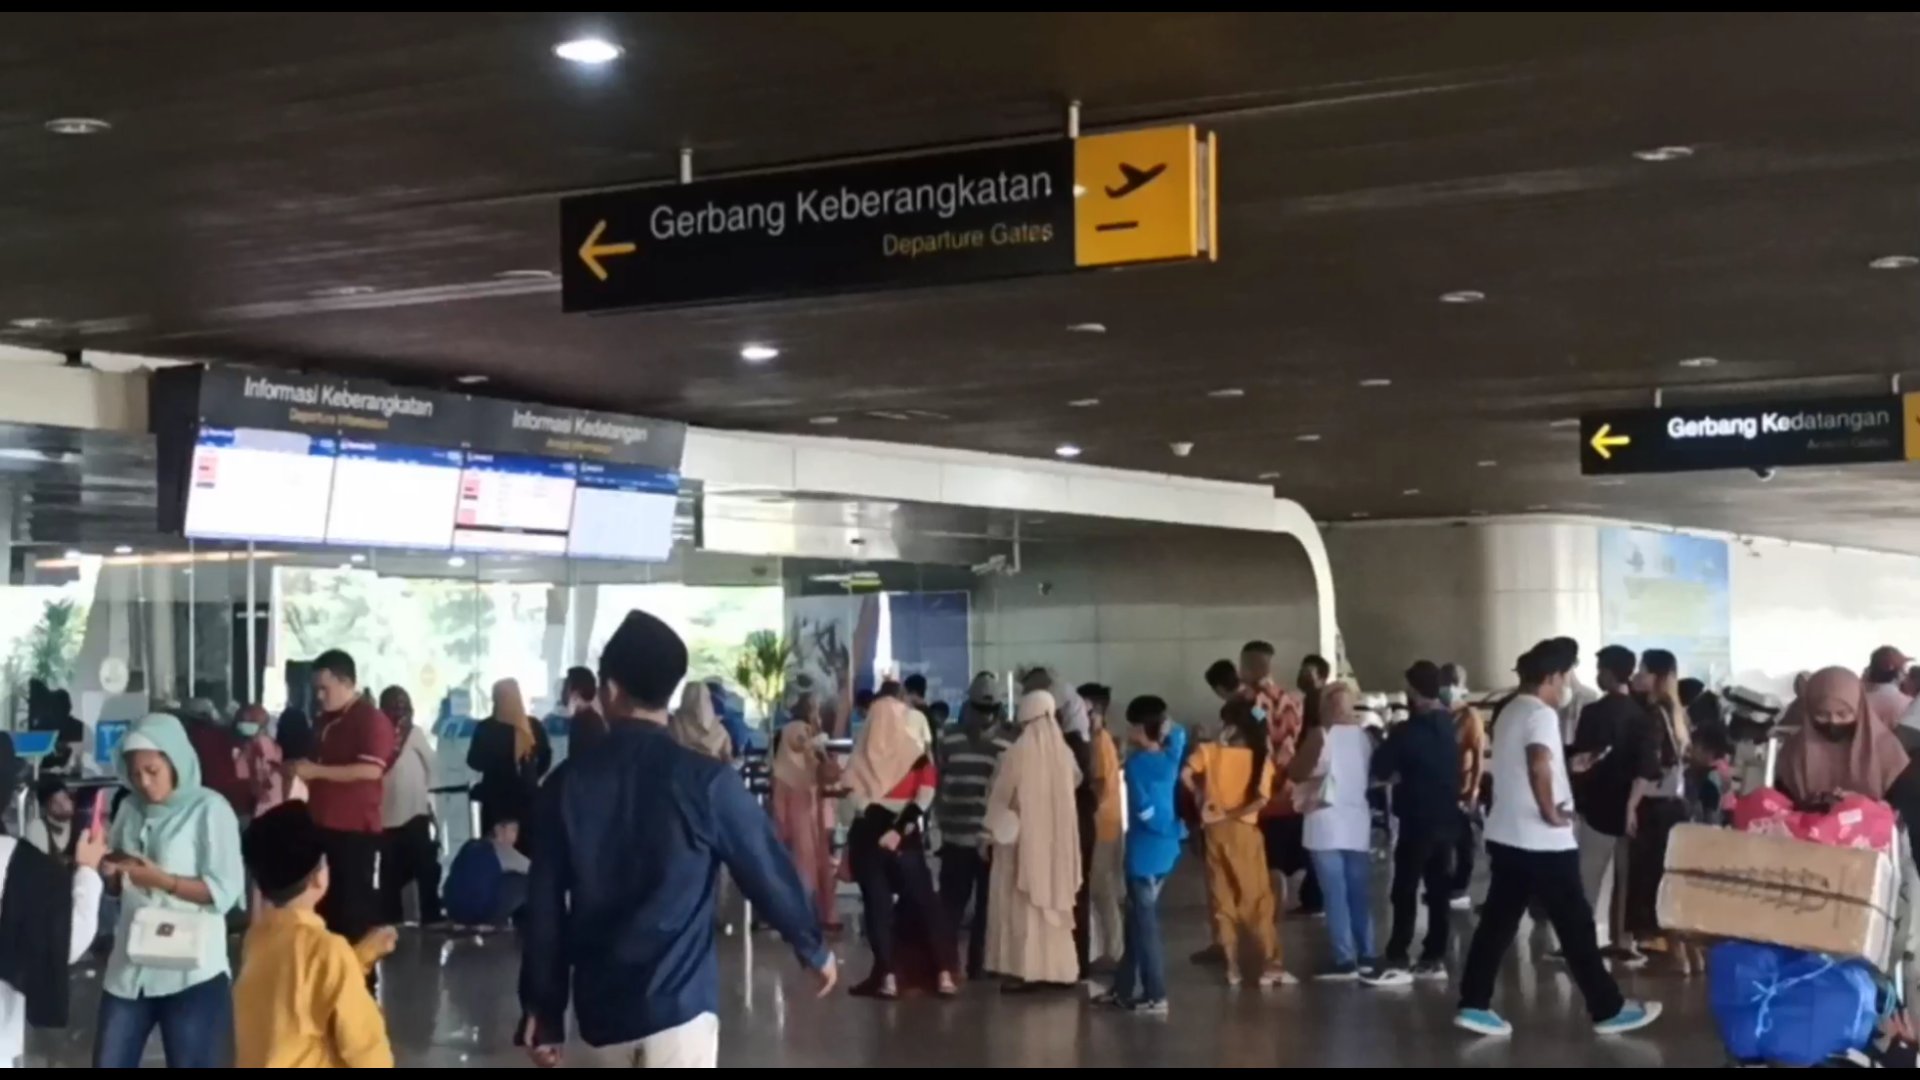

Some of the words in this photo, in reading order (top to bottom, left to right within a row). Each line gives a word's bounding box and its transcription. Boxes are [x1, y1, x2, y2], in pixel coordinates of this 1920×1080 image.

[650, 200, 786, 239] Gerbang
[796, 169, 1053, 225] Keberangkatan
[882, 231, 984, 257] Departure
[990, 223, 1053, 246] Gates
[243, 377, 319, 404] Informasi
[321, 385, 434, 417] Keberangkatan
[512, 409, 572, 434] Informasi
[574, 416, 648, 445] Kedatangan
[1667, 415, 1757, 439] Gerbang
[1761, 410, 1890, 433] Kedatangan
